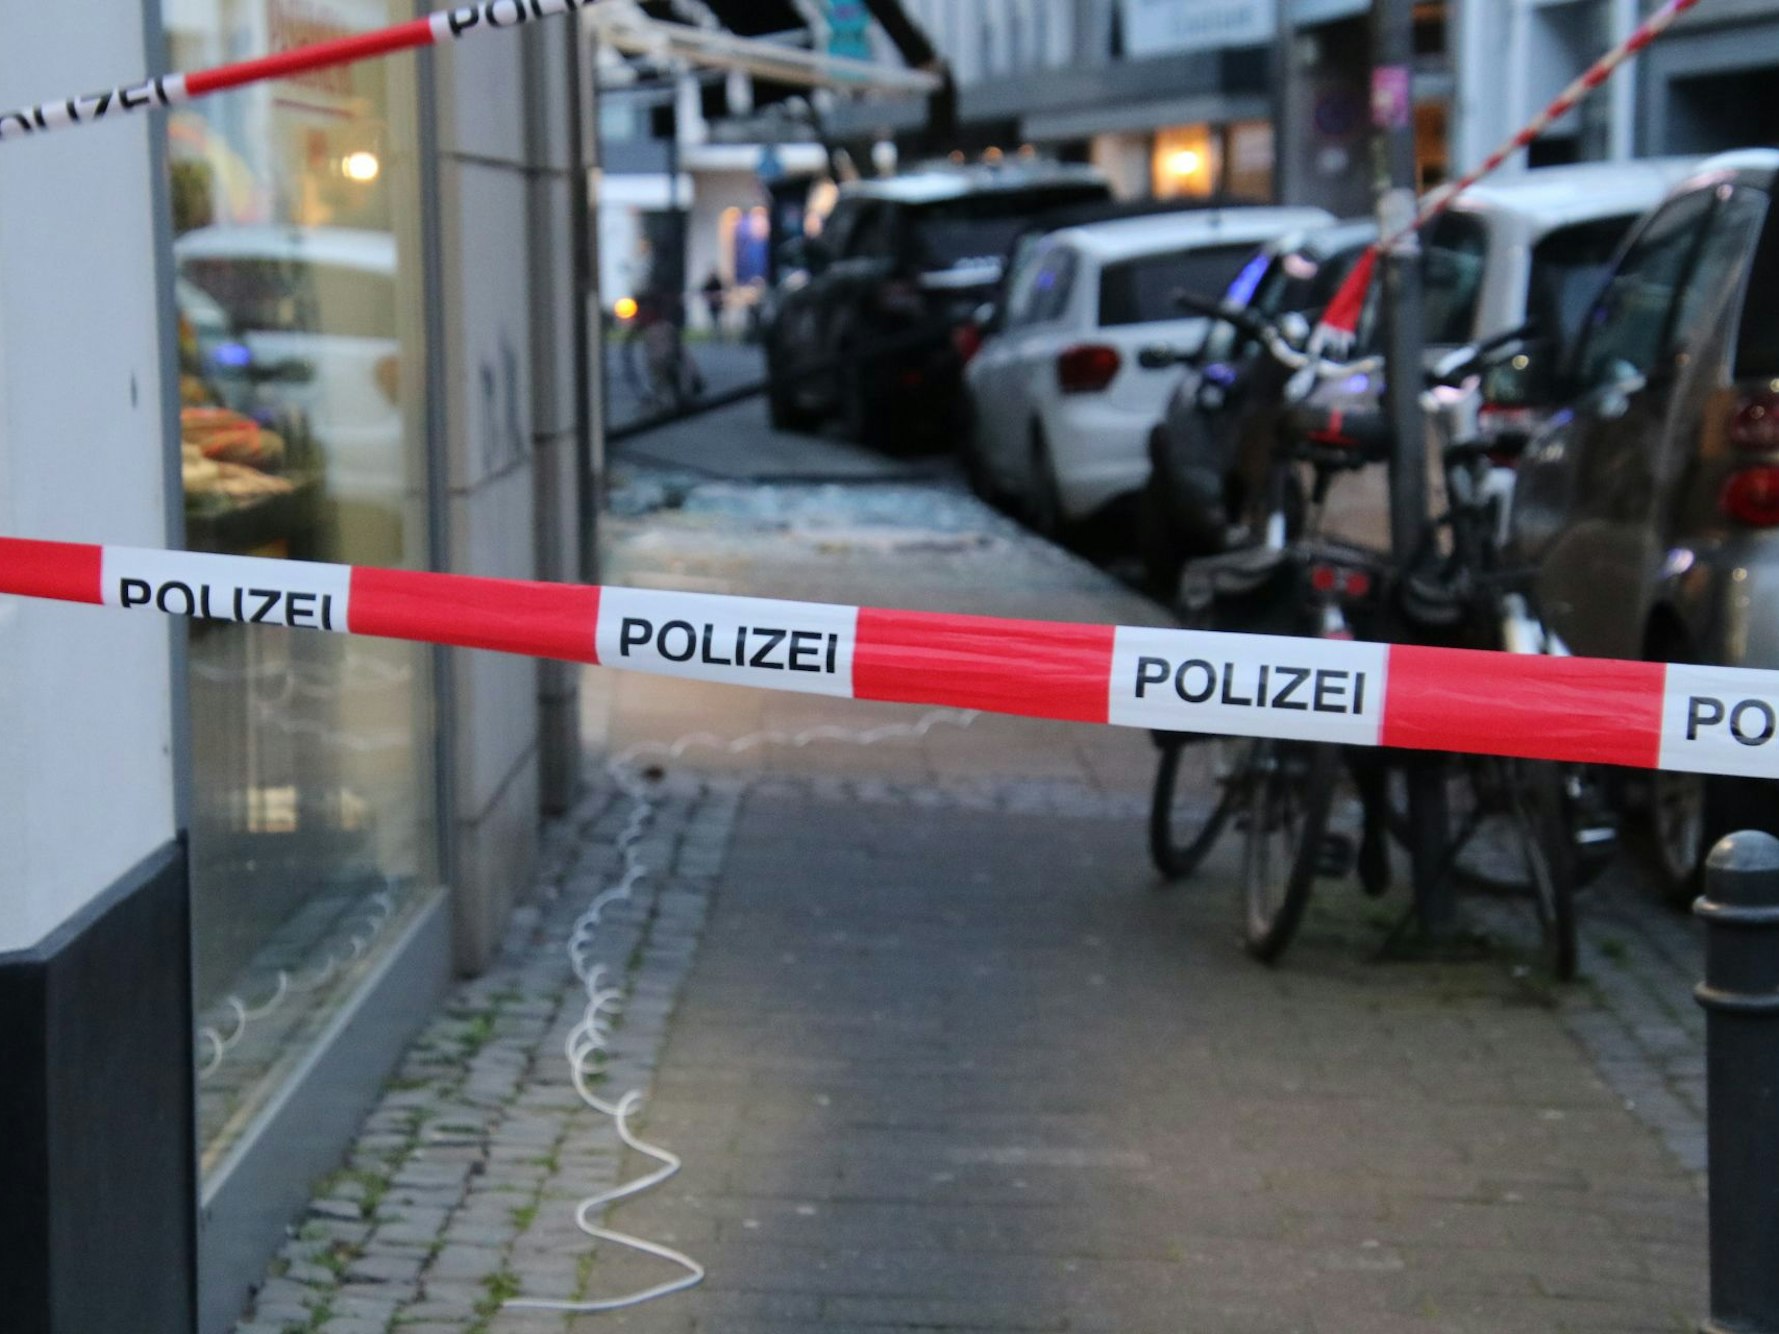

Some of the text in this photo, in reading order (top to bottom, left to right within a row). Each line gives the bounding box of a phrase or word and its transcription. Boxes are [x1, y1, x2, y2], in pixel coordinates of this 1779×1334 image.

[120, 577, 1776, 746] POLIZEI POLIZEI POLIZEI PO
